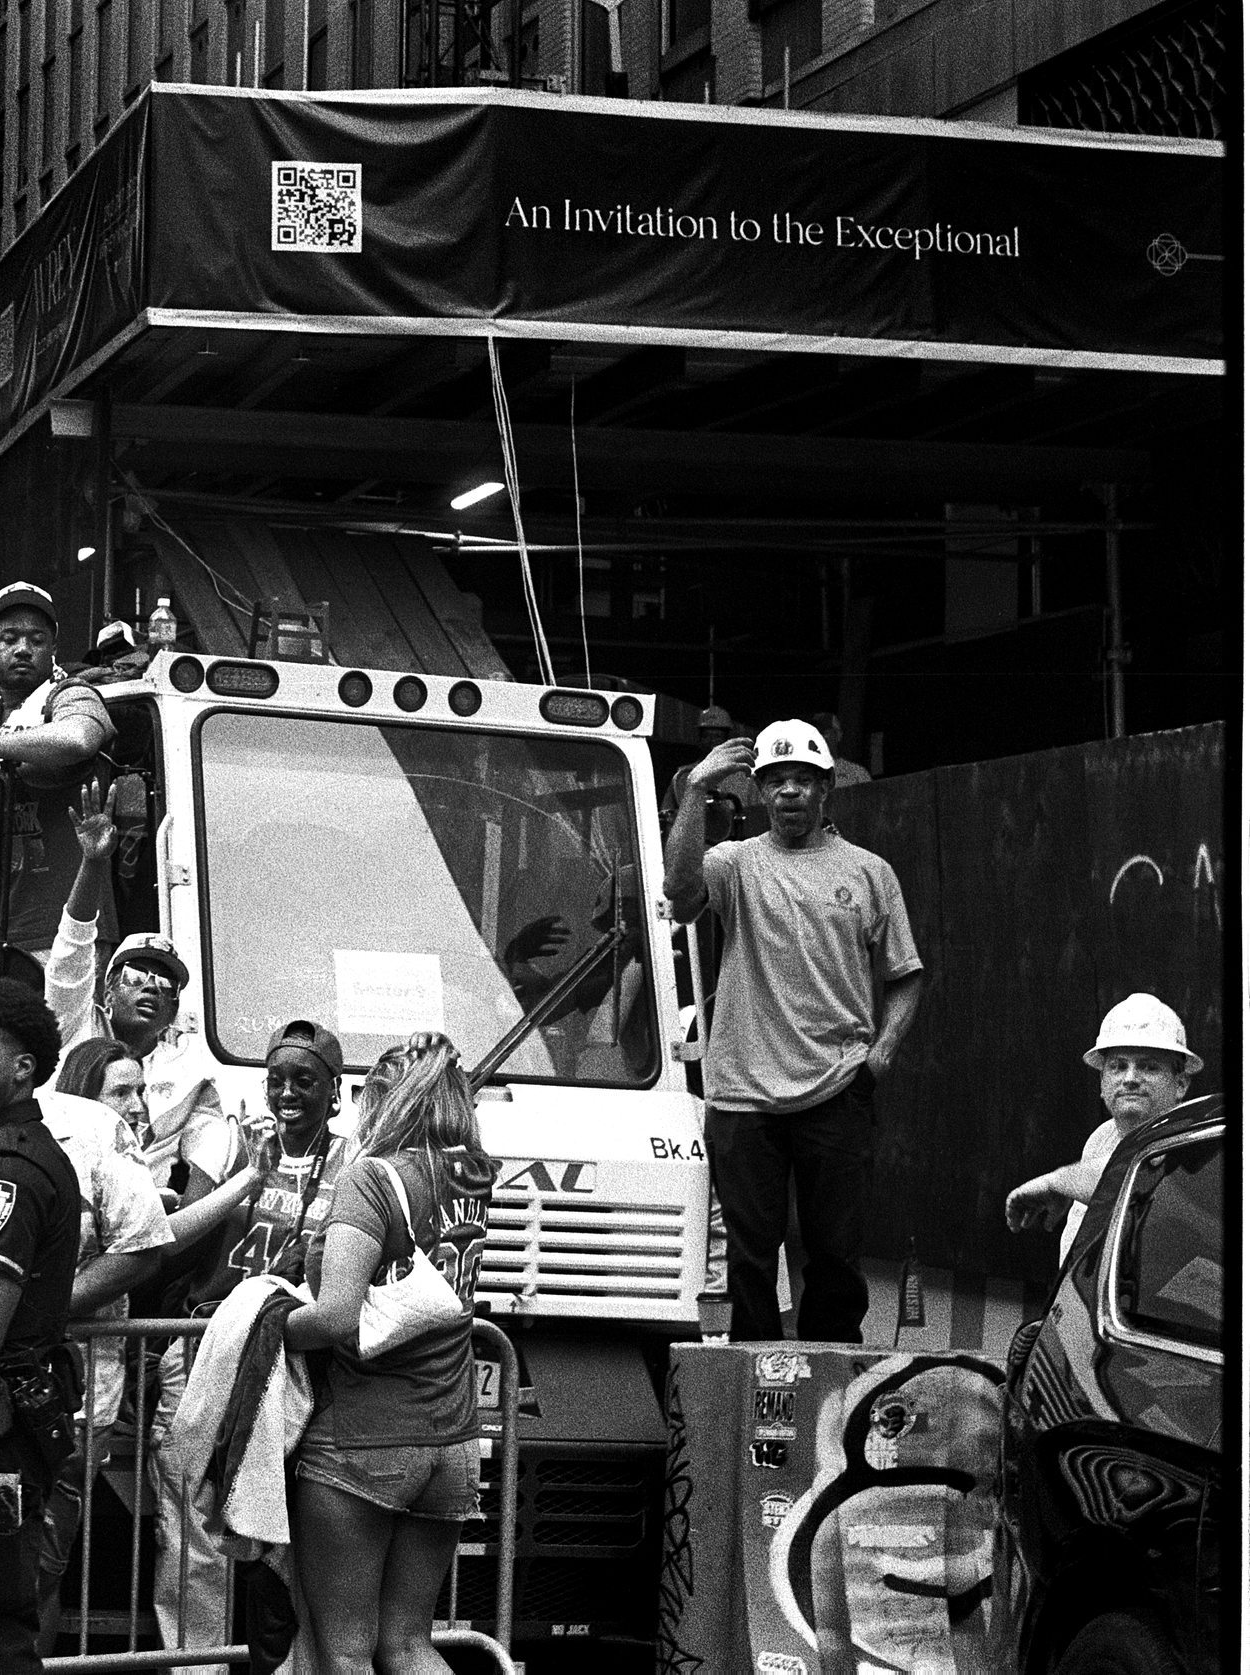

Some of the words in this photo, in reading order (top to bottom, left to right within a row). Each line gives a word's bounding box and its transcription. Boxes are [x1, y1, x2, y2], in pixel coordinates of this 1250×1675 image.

[504, 195, 552, 229] An
[563, 199, 718, 240] Invitation
[729, 210, 761, 240] to
[772, 211, 824, 246] the
[836, 215, 1021, 261] Exceptional
[649, 1136, 705, 1162] Bk.4
[429, 1197, 490, 1238] ANDL
